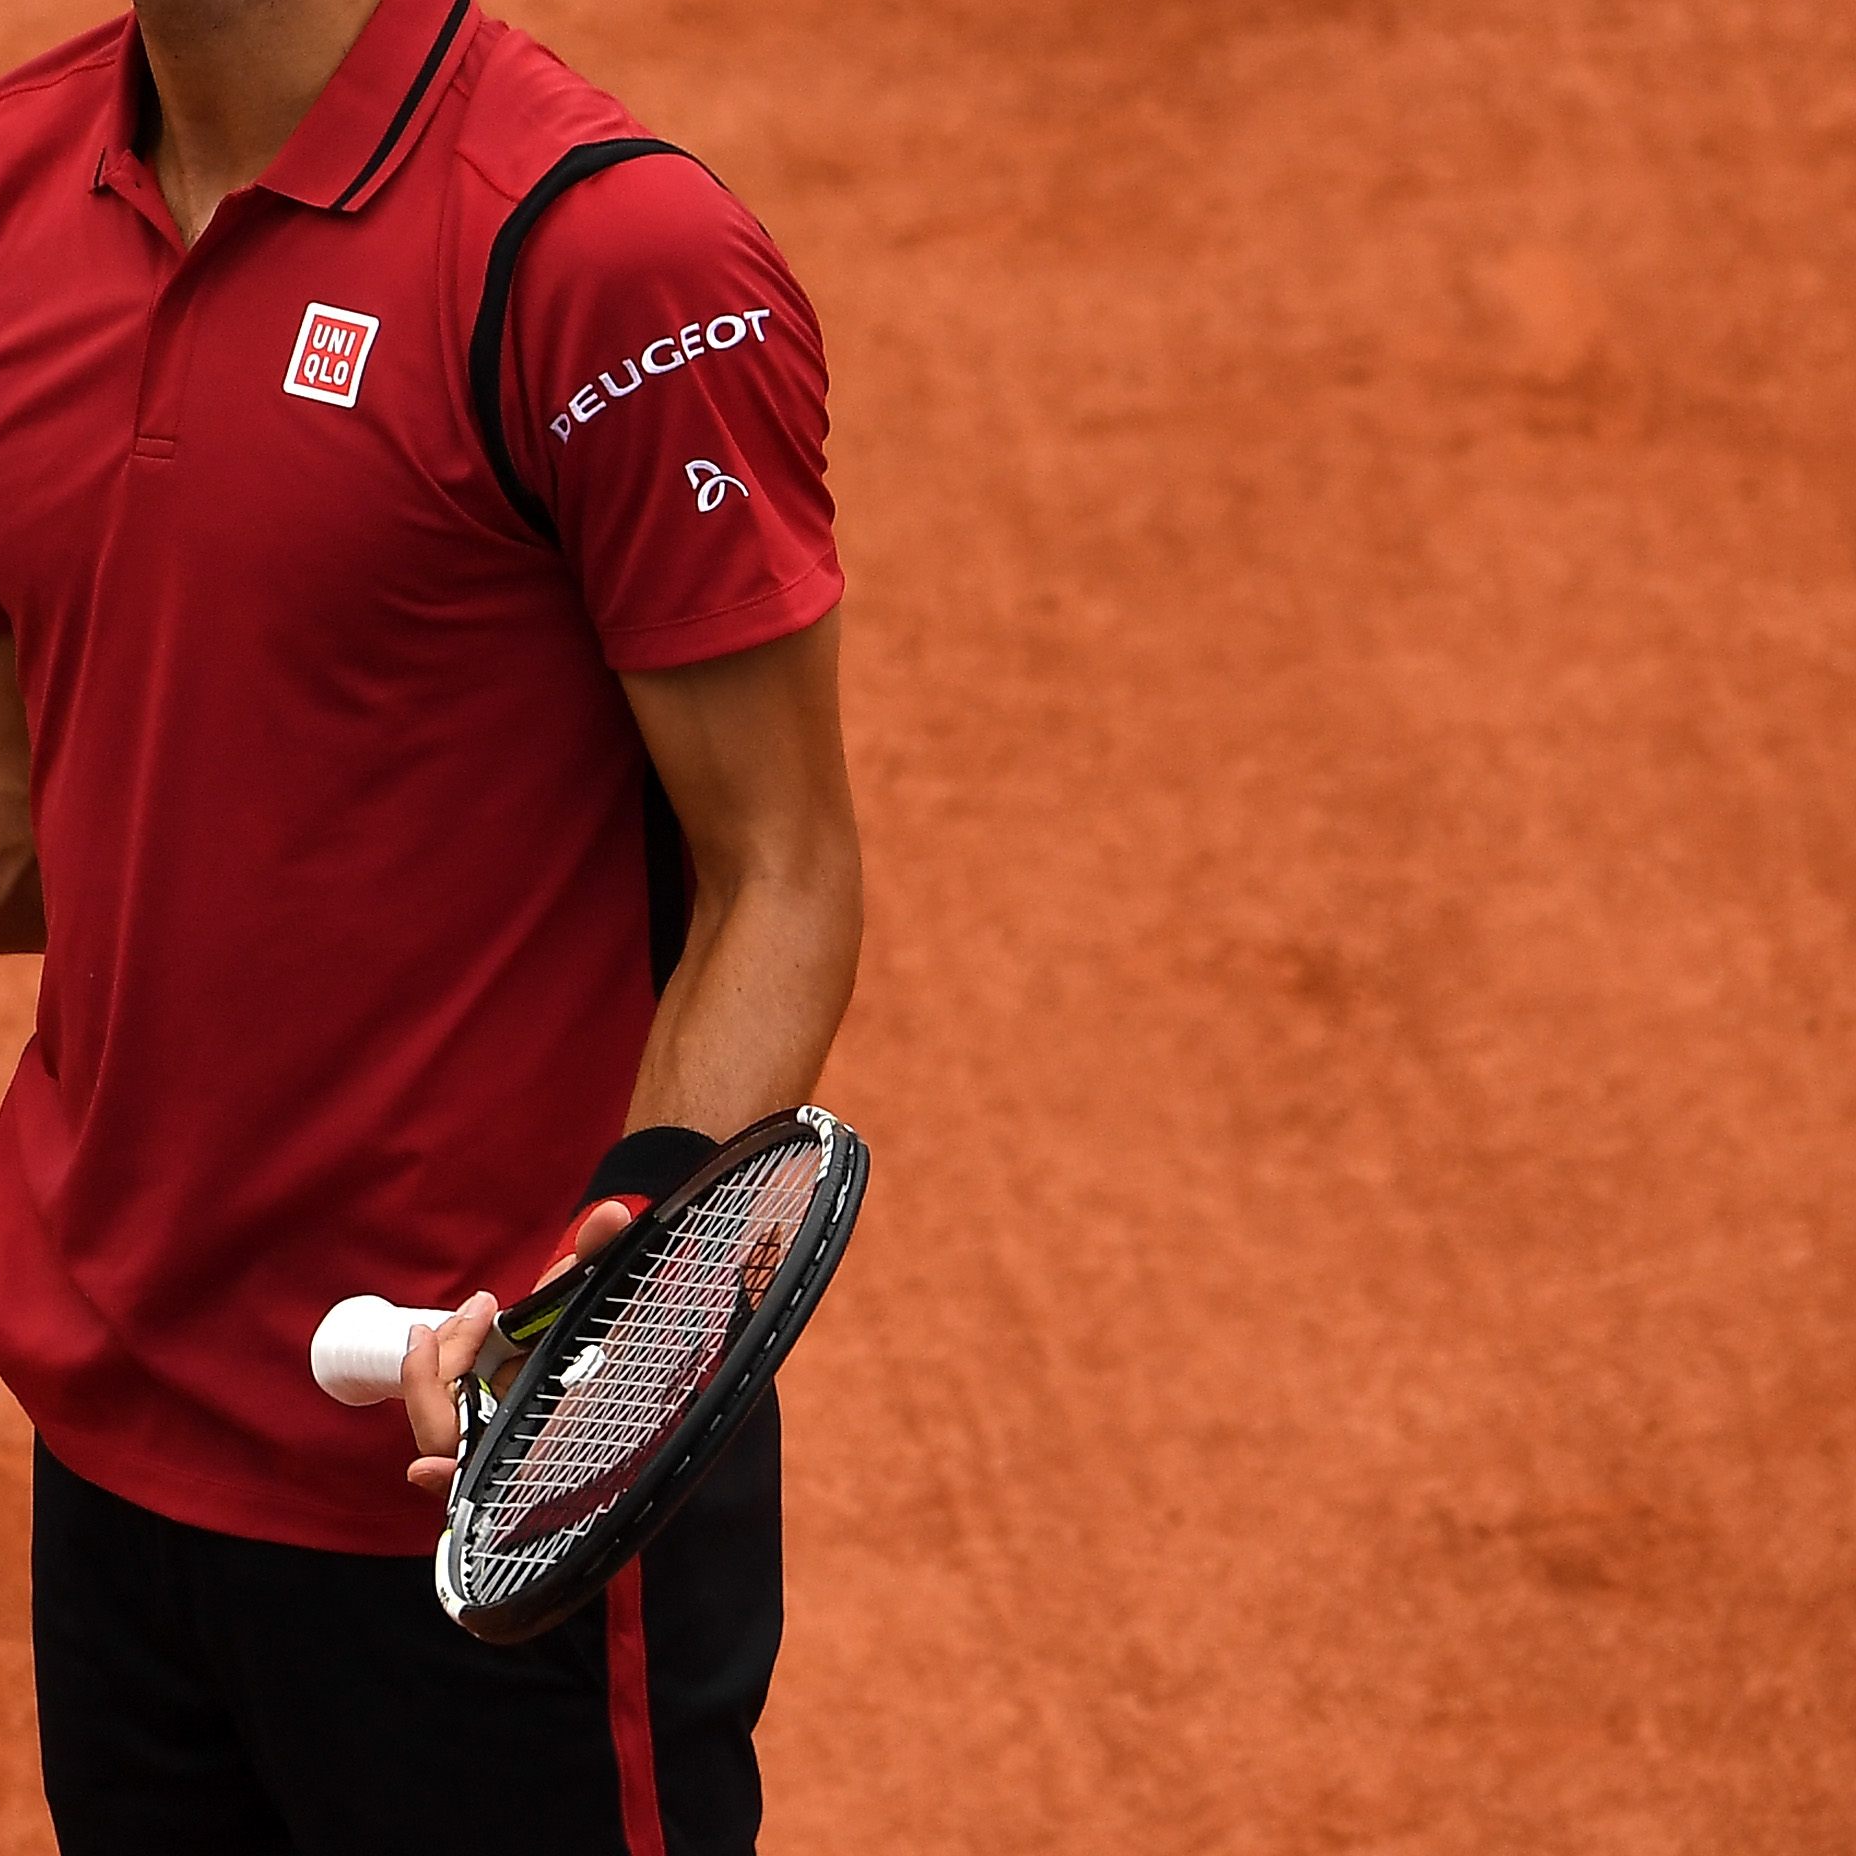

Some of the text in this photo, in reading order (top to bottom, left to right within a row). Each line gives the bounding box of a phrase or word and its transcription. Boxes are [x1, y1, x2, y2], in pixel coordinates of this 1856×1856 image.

[312, 323, 357, 357] UNI
[303, 353, 350, 386] QLO
[549, 309, 770, 444] PEUGEOT
